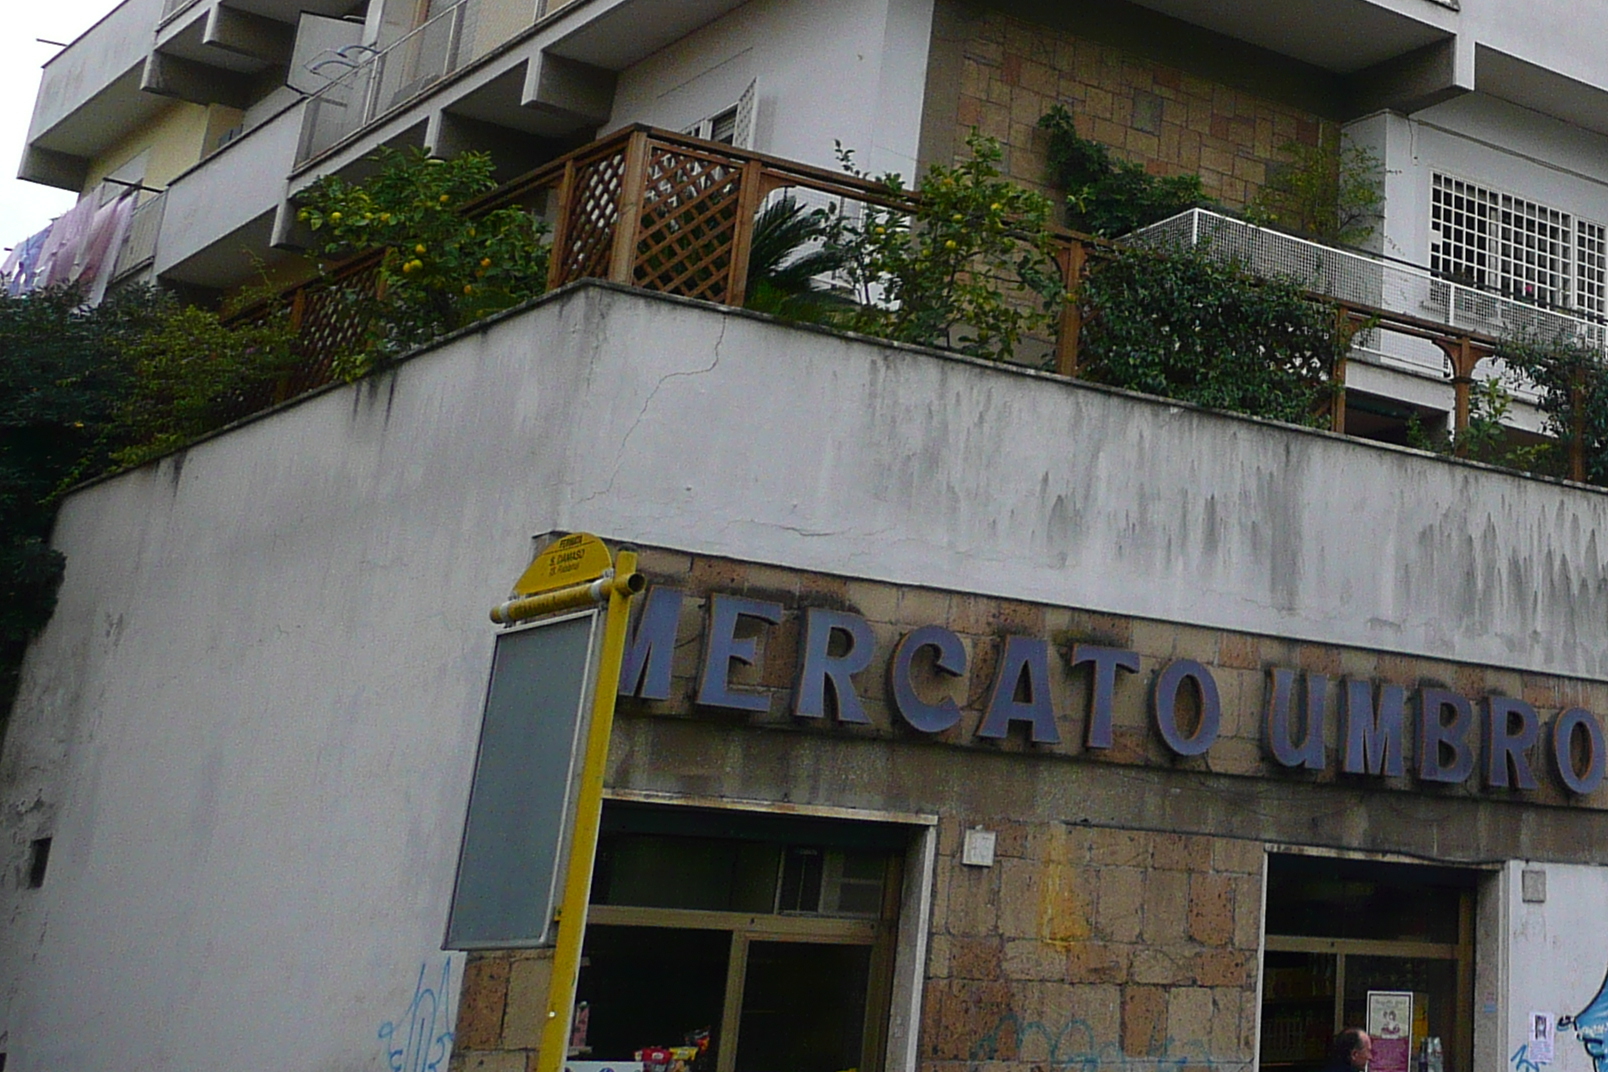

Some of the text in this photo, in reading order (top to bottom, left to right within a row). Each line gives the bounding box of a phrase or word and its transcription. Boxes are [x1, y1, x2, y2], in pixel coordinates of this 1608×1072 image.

[557, 549, 585, 564] DAMASO
[617, 584, 1606, 795] MERCATO UMBRO
